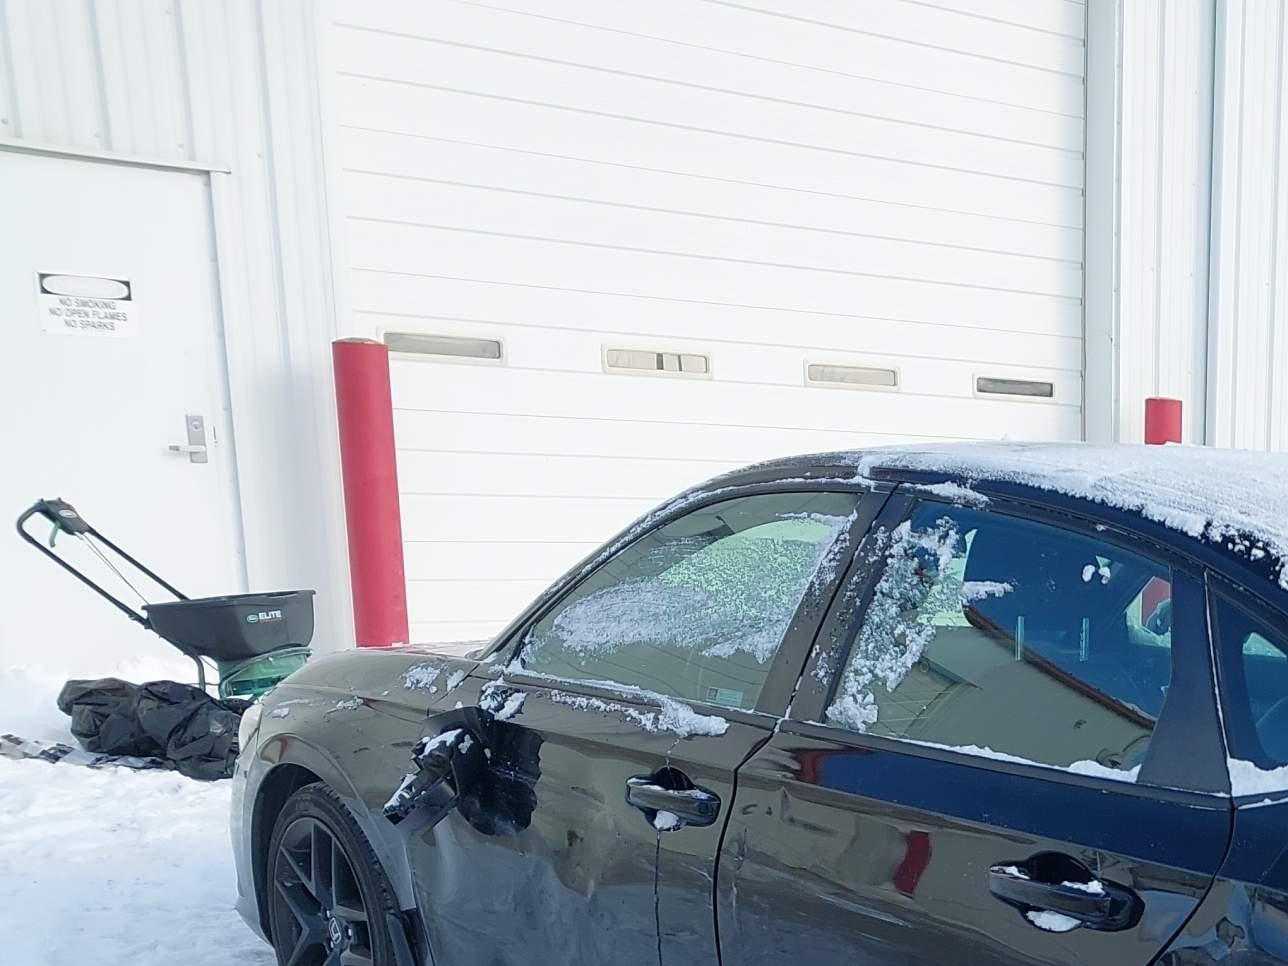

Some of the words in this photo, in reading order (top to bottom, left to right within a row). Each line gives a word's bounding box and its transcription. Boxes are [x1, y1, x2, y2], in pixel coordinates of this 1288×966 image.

[58, 297, 73, 307] NO
[74, 299, 116, 310] SMOKING
[49, 307, 63, 317] NO
[65, 308, 89, 319] OPEN
[93, 310, 128, 321] FLAMES
[64, 319, 78, 328] NO
[80, 320, 115, 330] SPARKS
[259, 610, 282, 619] ELITE
